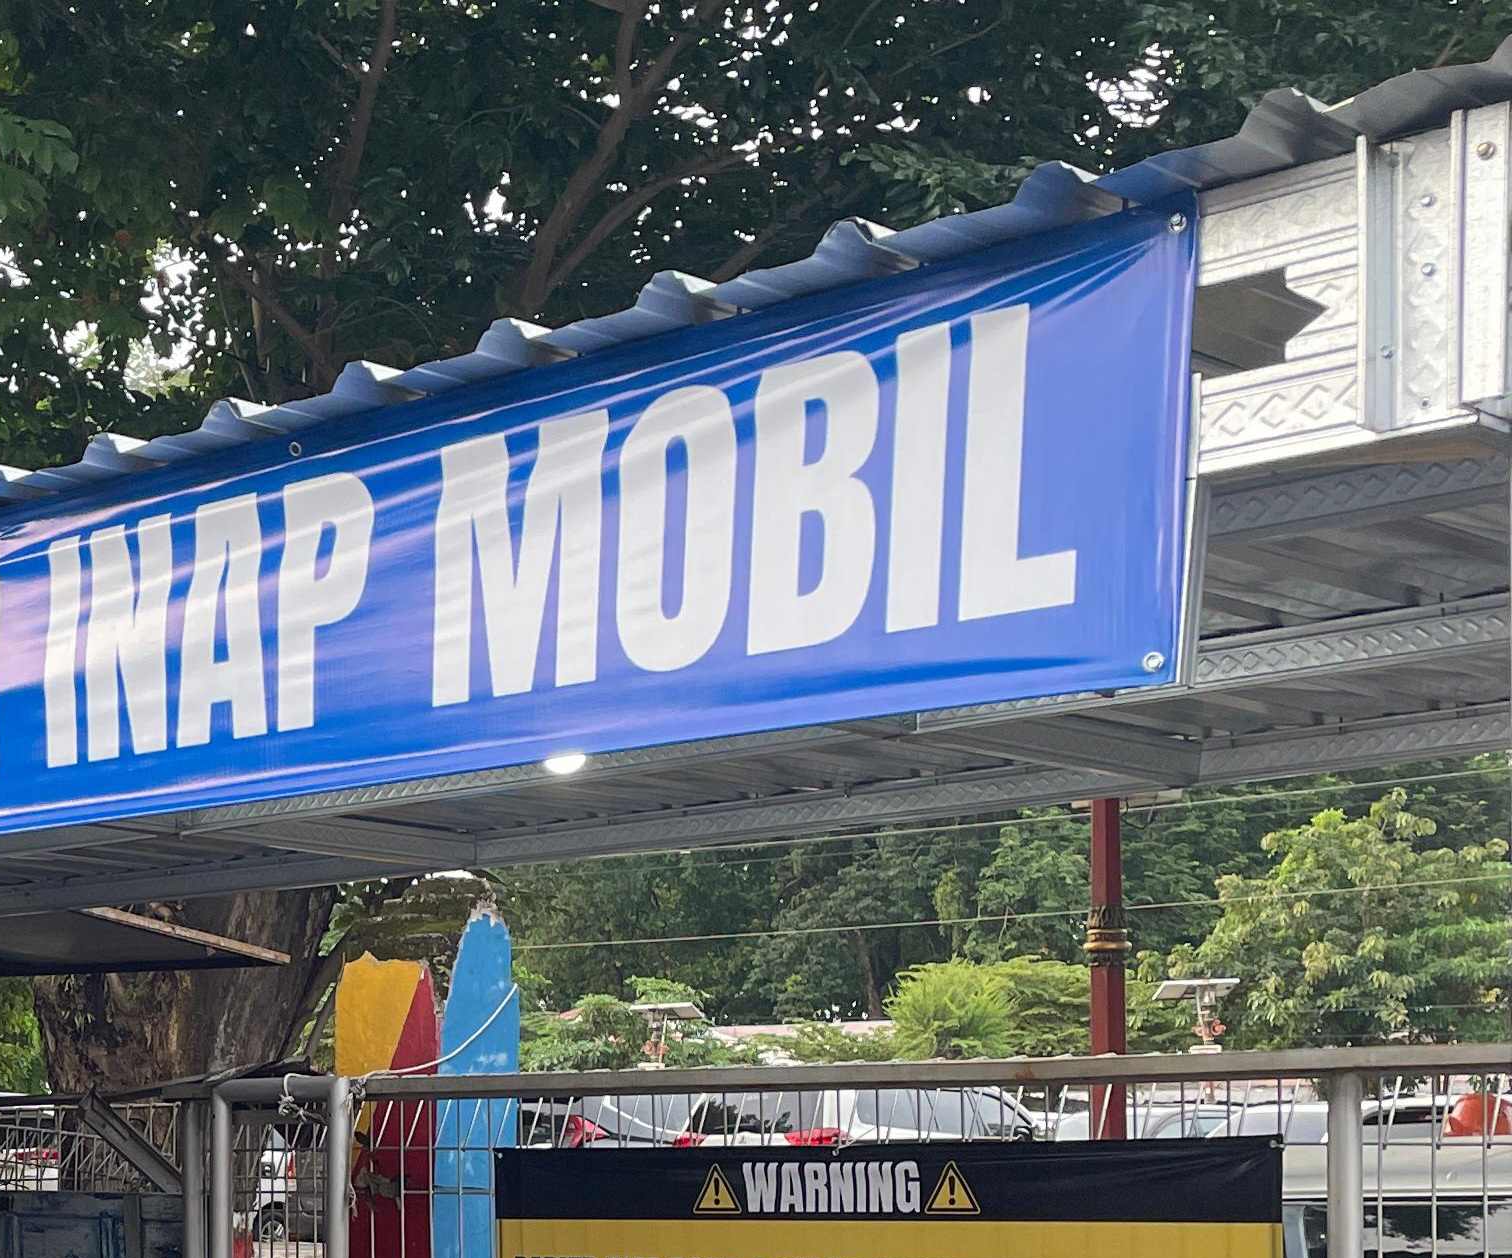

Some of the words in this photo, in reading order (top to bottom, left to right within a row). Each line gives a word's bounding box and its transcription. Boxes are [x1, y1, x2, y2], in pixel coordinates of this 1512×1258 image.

[43, 472, 375, 768] INAP
[432, 303, 1076, 707] MOBIL
[742, 1160, 921, 1214] WARNING
